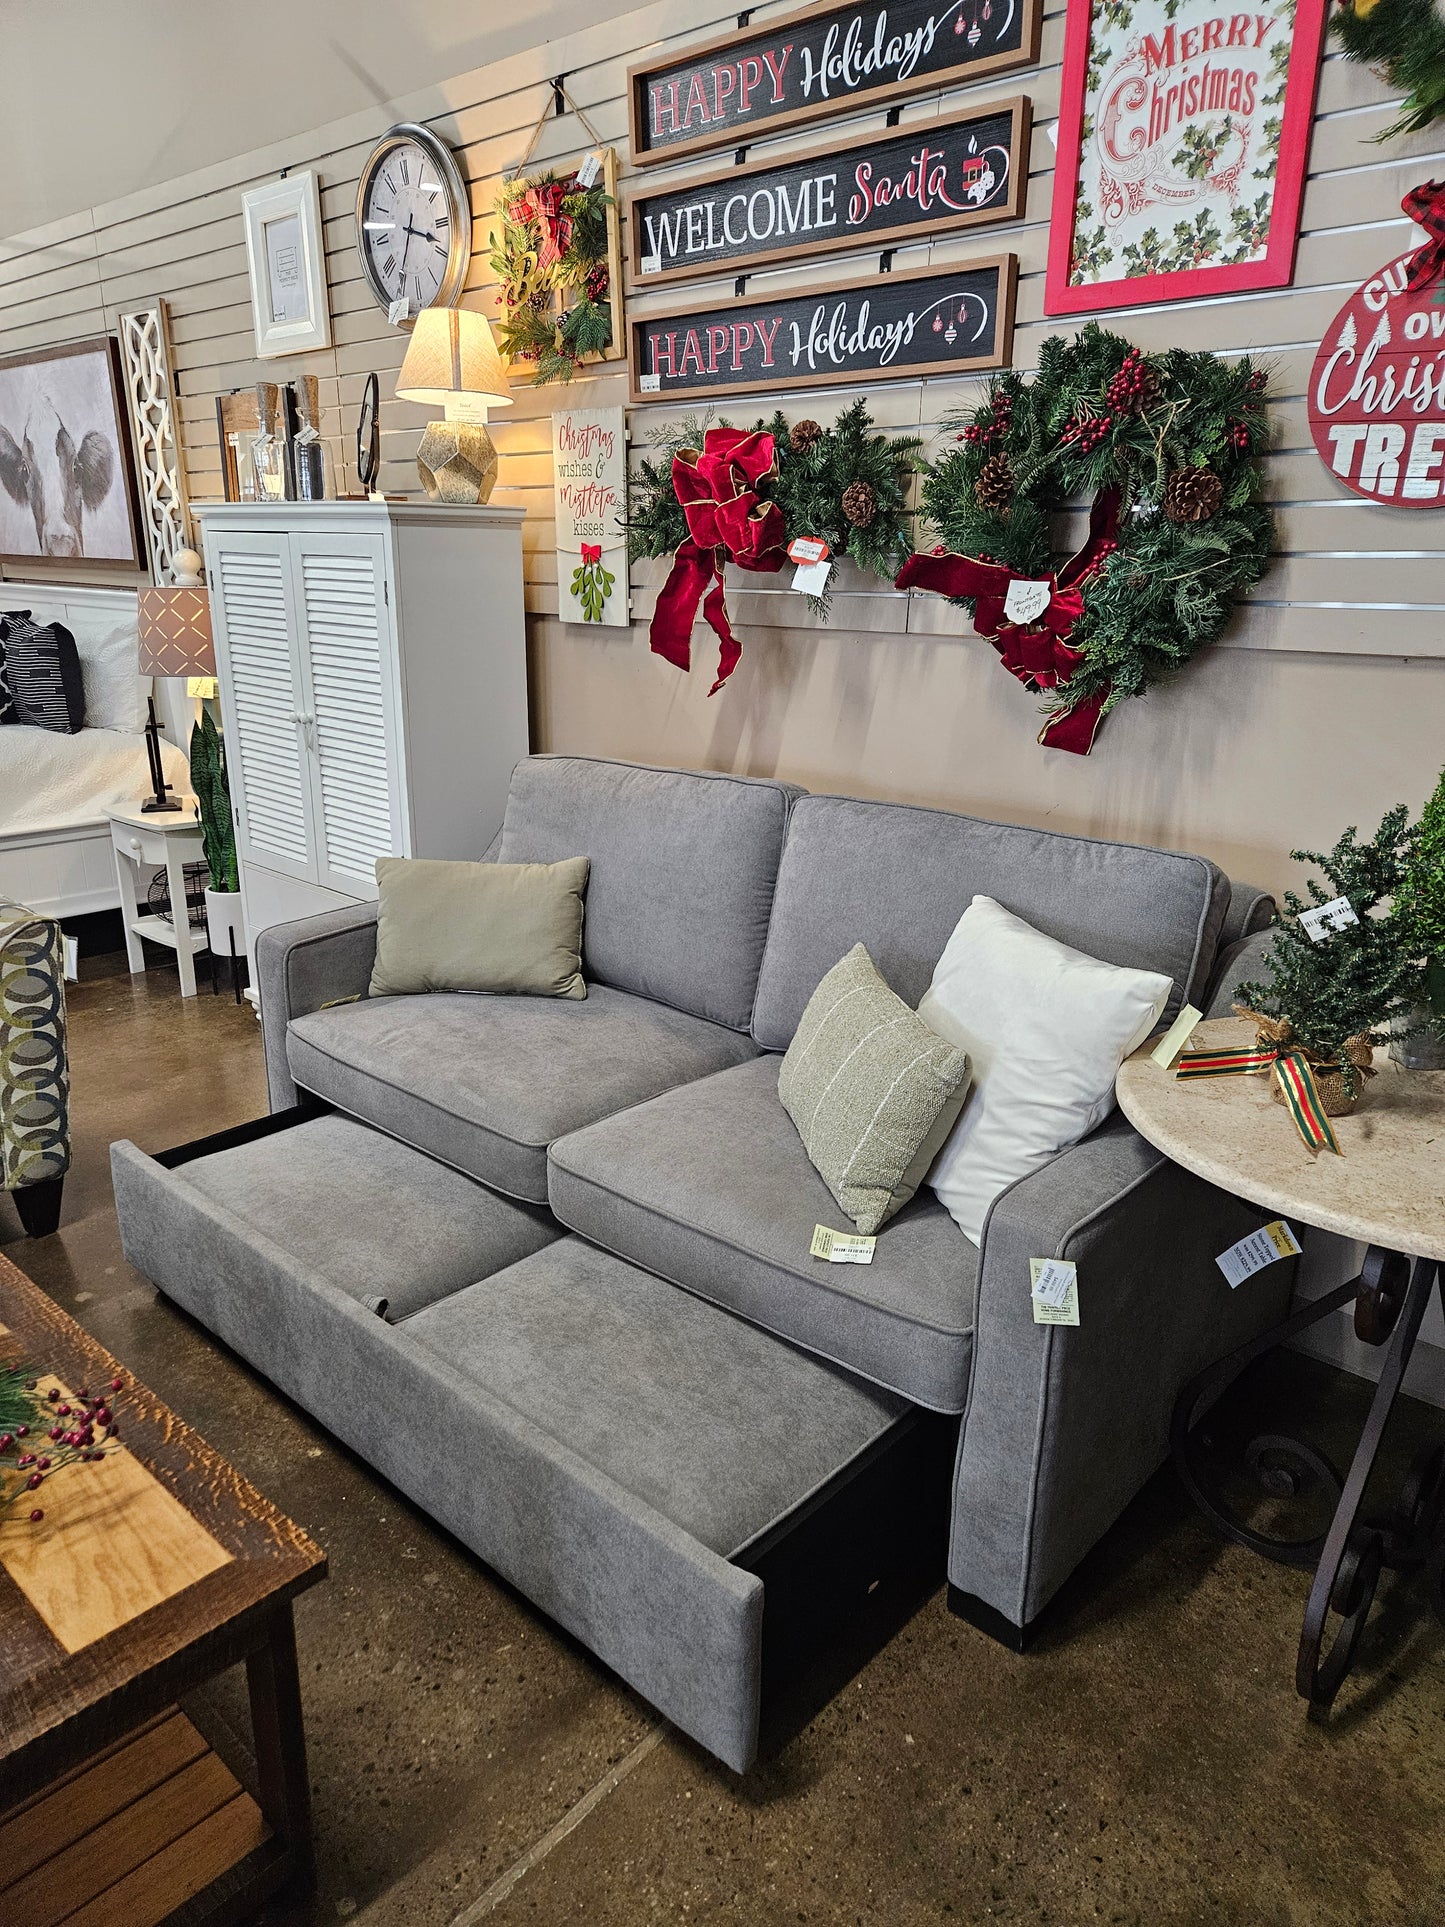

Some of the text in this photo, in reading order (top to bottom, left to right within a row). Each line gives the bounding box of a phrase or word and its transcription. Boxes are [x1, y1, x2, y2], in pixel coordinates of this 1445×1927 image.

[1140, 13, 1277, 78] MERRY
[651, 10, 936, 137] HAPPY Holidays
[1100, 58, 1258, 162] Christmas
[643, 147, 948, 258] WELCOME Santa
[1152, 183, 1196, 198] DECEMBER
[1363, 254, 1414, 312] CU
[648, 300, 918, 378] HAPPY Holidays
[559, 416, 615, 460] Christmas
[1328, 422, 1445, 499] TRE
[558, 452, 606, 479] wishes &
[560, 481, 617, 520] Mistletoe
[573, 519, 605, 536] kisses
[1271, 1234, 1282, 1249] Price
[1277, 1225, 1294, 1252] Markdown
